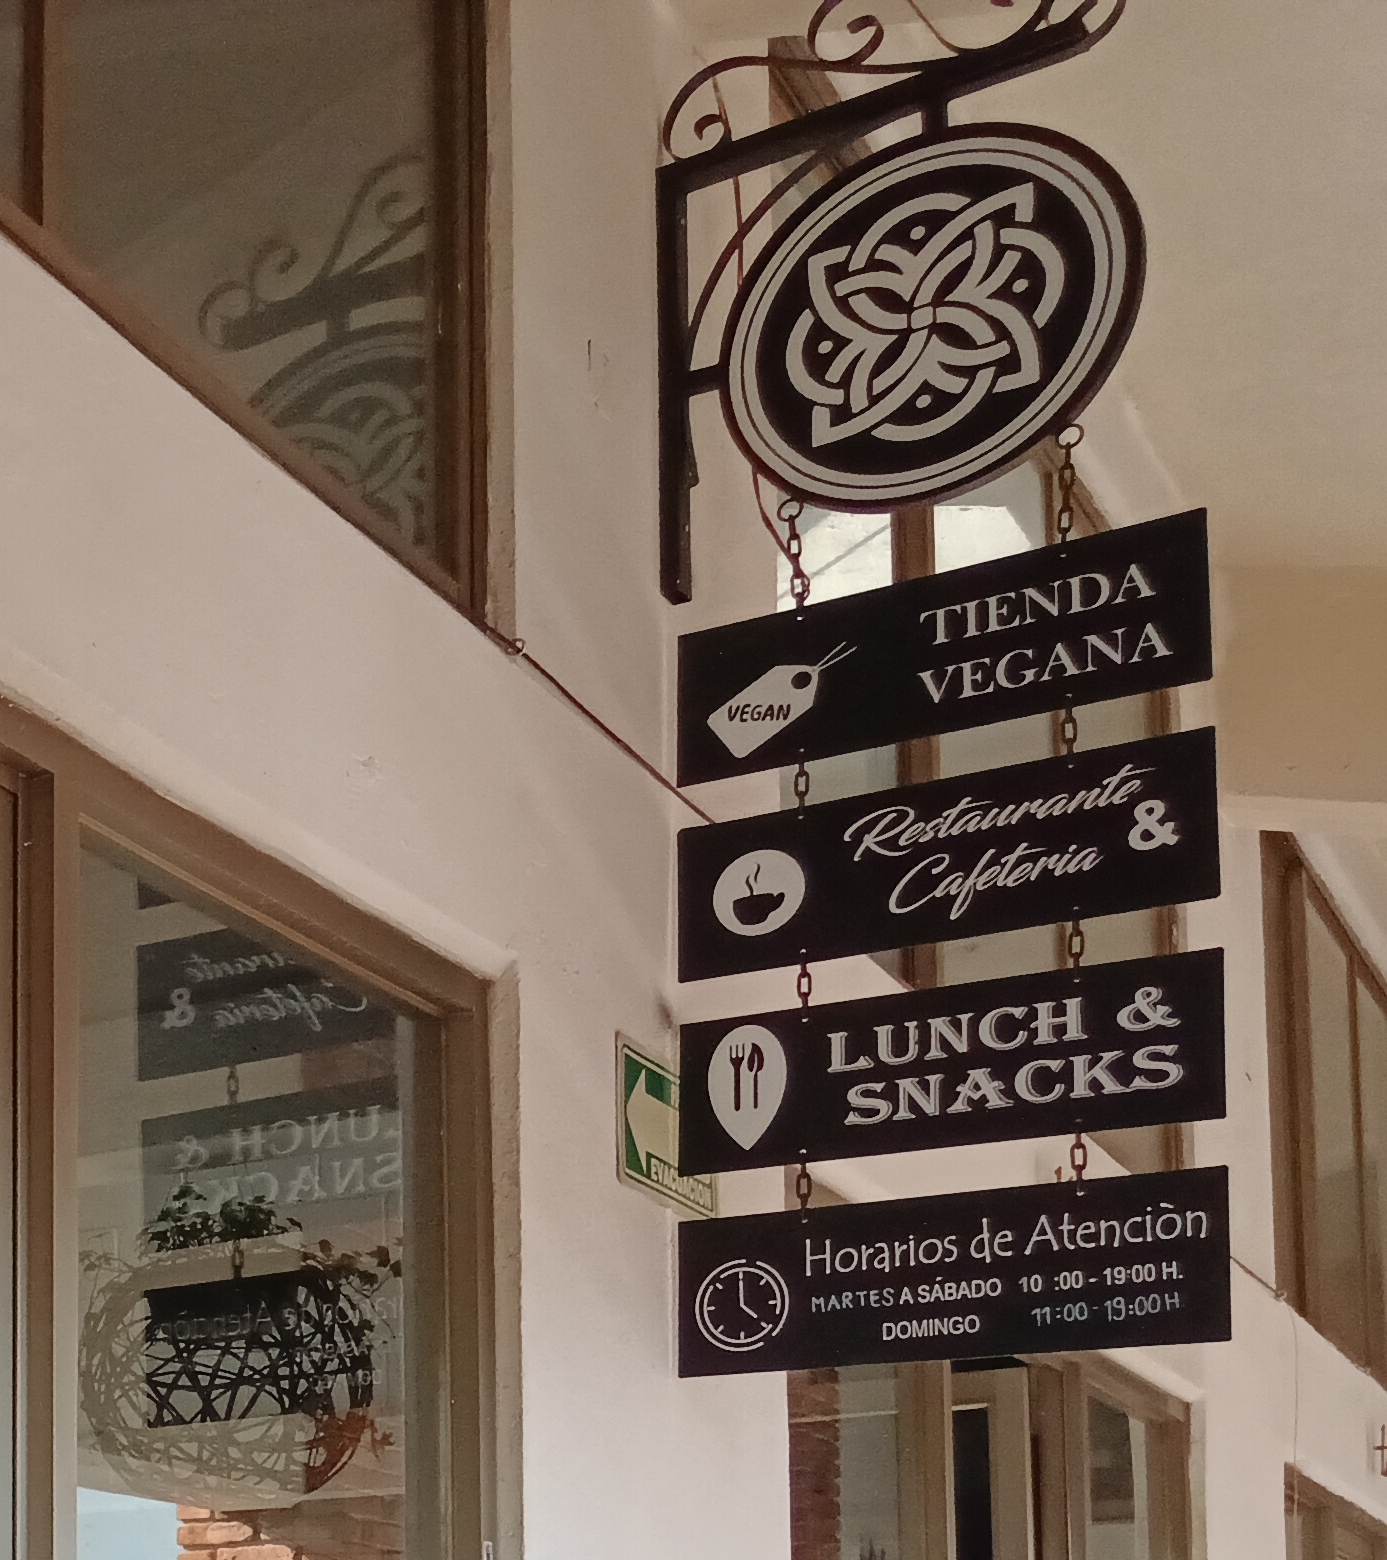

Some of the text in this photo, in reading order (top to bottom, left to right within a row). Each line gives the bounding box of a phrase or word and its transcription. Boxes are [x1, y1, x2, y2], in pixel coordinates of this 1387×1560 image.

[920, 564, 1156, 646] TIENDA
[917, 622, 1173, 704] VEGANA
[727, 703, 792, 722] VEGAN
[843, 764, 1180, 862] Restaurante &
[827, 986, 1181, 1073] LUNCH &
[844, 1045, 1184, 1125] SNACKS
[804, 1235, 958, 1277] Horarios
[970, 1218, 1013, 1263] de
[811, 1287, 895, 1313] MARTES
[899, 1287, 914, 1305] A
[917, 1276, 1002, 1303] SÁBADO
[1103, 1263, 1156, 1286] 19:00
[882, 1314, 980, 1341] DOMINGO
[1031, 1301, 1088, 1327] 11:00
[1104, 1293, 1161, 1322] 19:00
